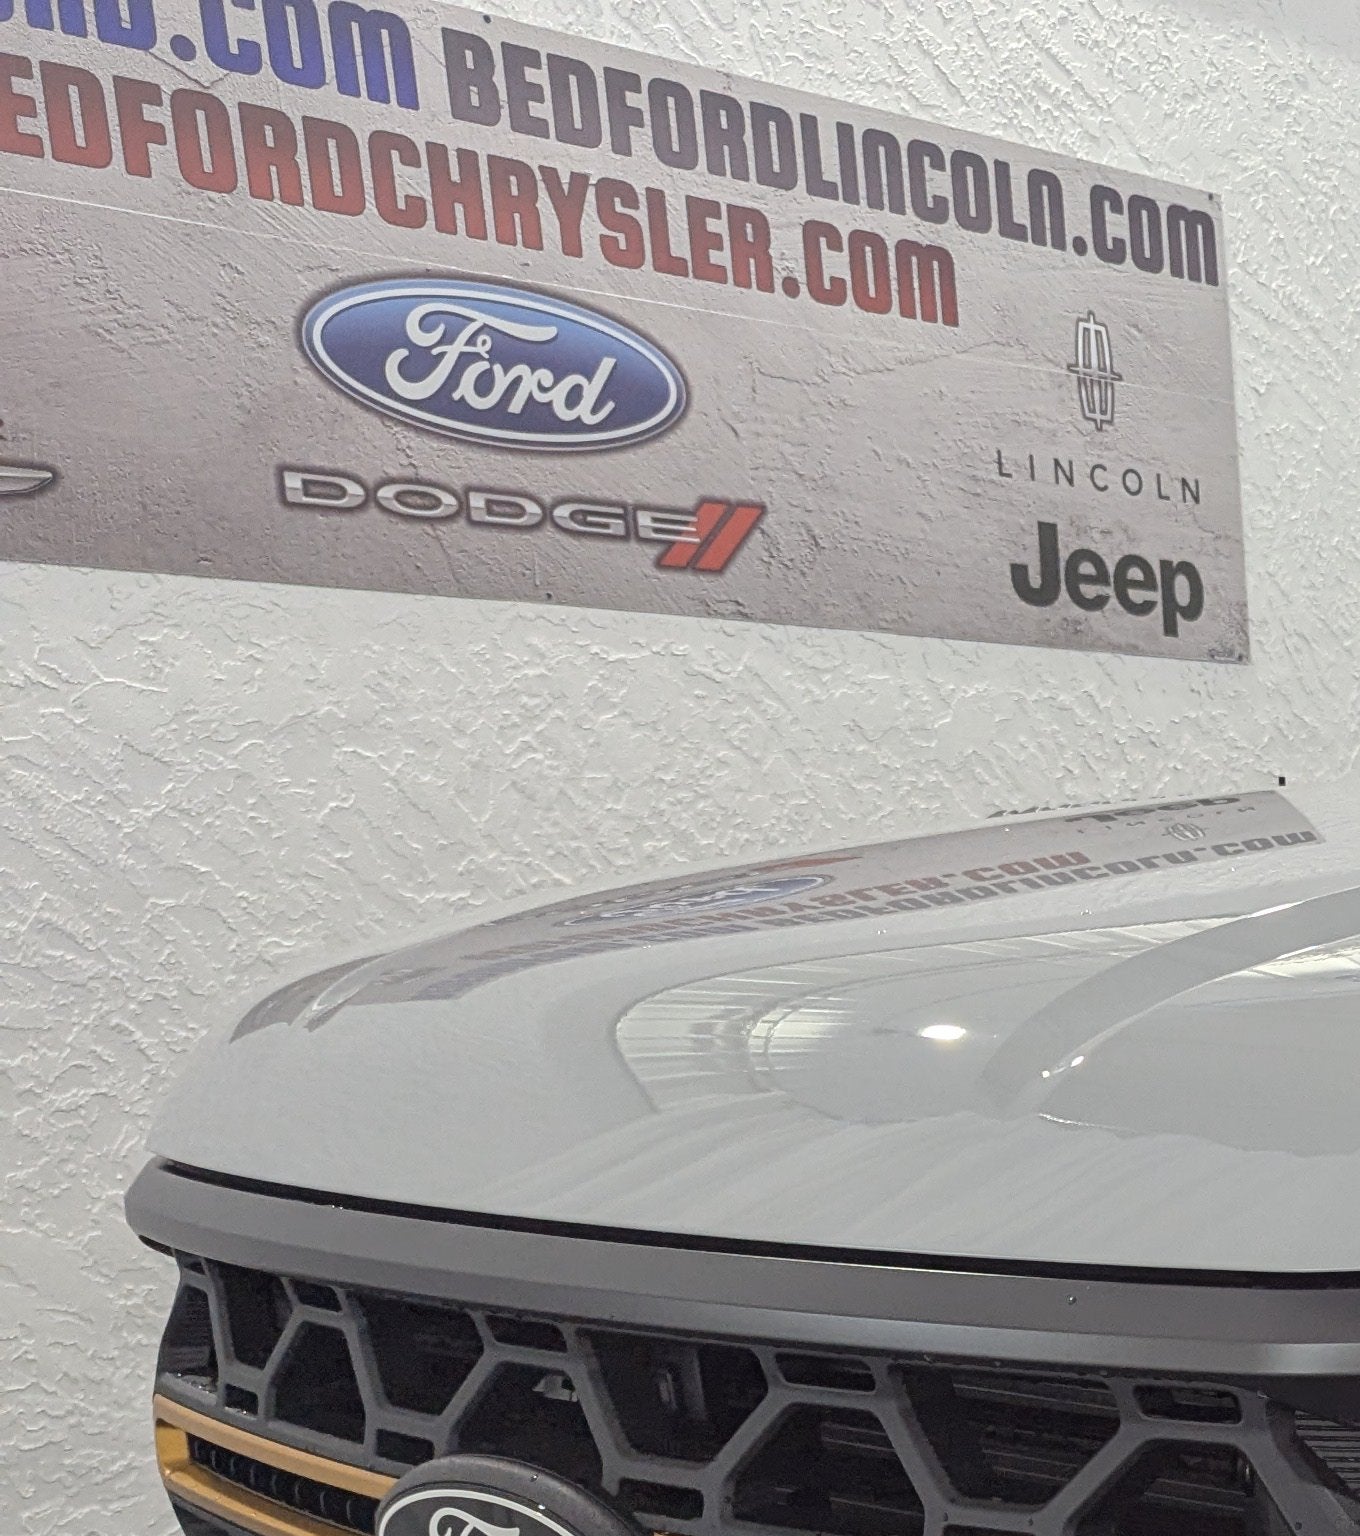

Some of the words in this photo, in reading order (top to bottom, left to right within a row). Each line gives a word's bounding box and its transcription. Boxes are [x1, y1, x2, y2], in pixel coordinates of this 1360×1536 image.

[440, 27, 1220, 288] BEDFORDLINCOLN.COM
[384, 303, 618, 426] Ford
[282, 470, 701, 544] DODGE
[996, 449, 1201, 505] LINCOLN
[1009, 520, 1205, 639] Jeep
